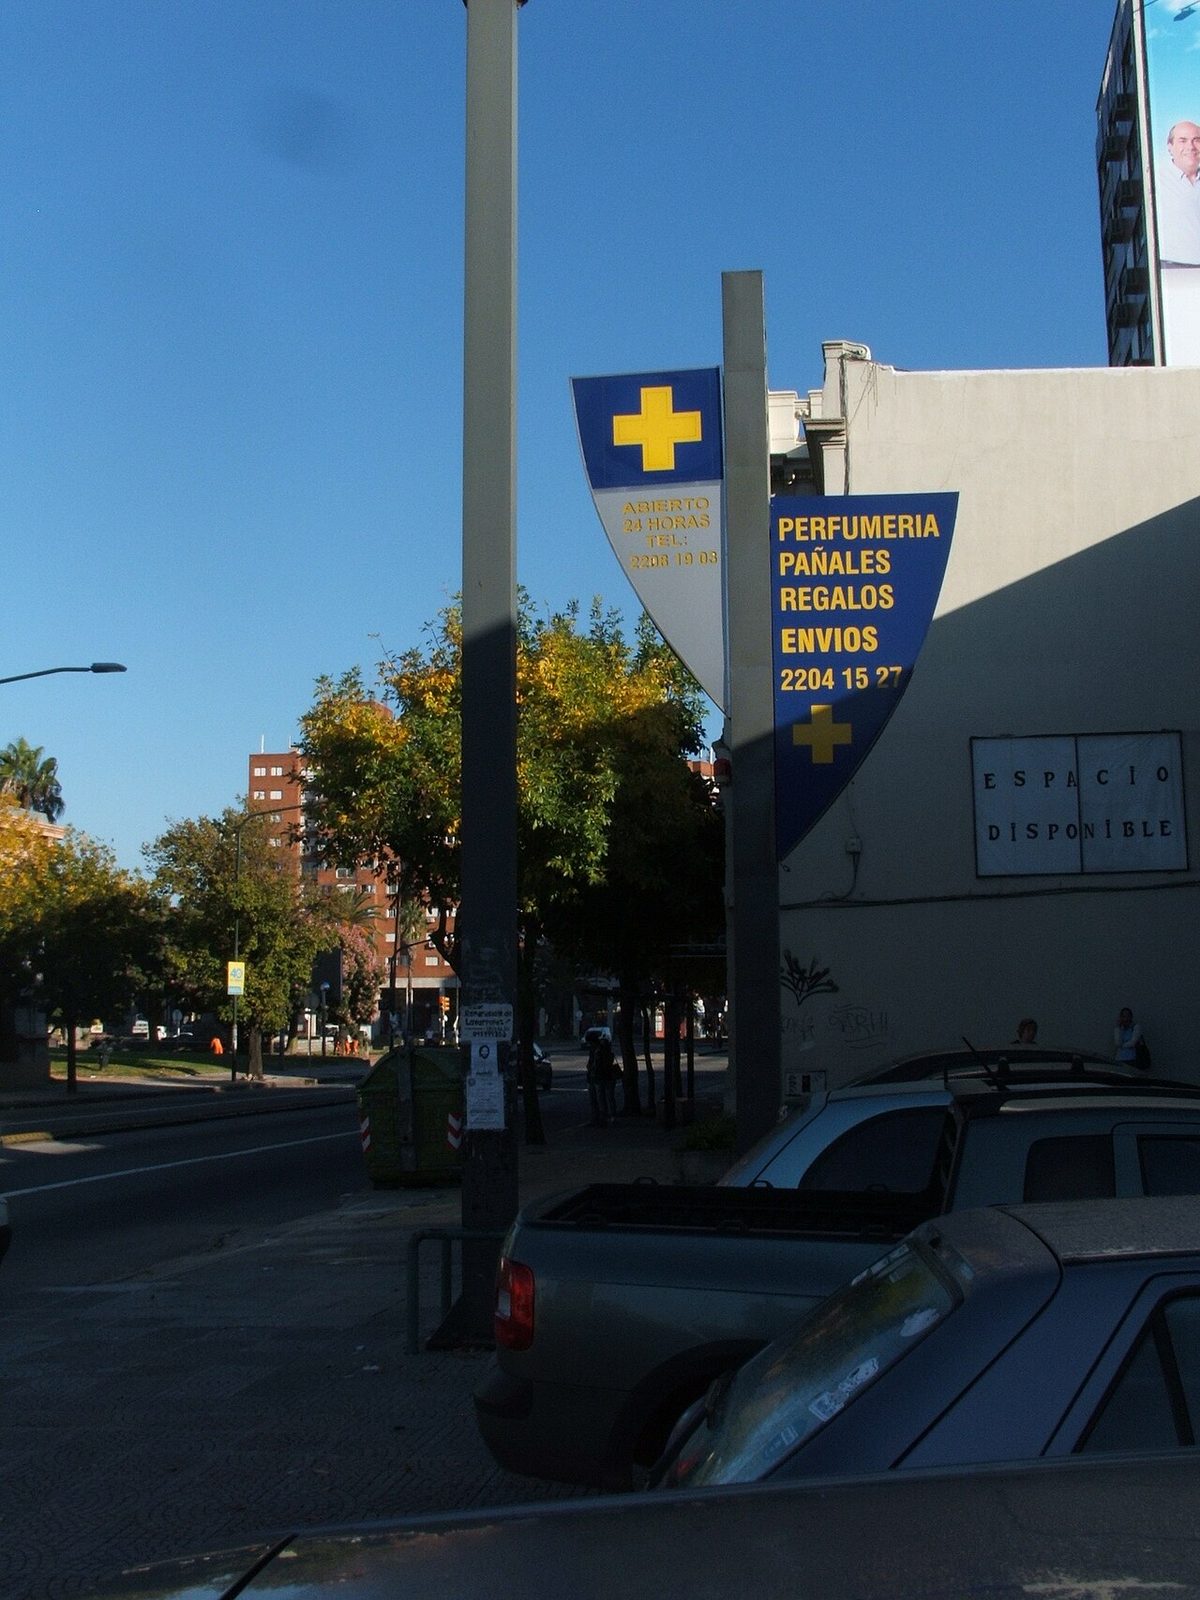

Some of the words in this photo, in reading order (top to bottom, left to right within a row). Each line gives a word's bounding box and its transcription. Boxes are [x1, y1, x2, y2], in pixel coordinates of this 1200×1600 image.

[623, 497, 709, 515] ABIERTO
[624, 518, 642, 532] 24
[647, 513, 710, 531] HORAS
[777, 513, 940, 541] PERFUMERIA
[675, 552, 693, 566] 19
[779, 546, 891, 576] PAÑALES
[780, 584, 894, 611] REGALOS
[781, 625, 878, 653] ENVIOS
[780, 667, 834, 691] 2204
[842, 667, 868, 689] 15
[875, 666, 902, 688] 27
